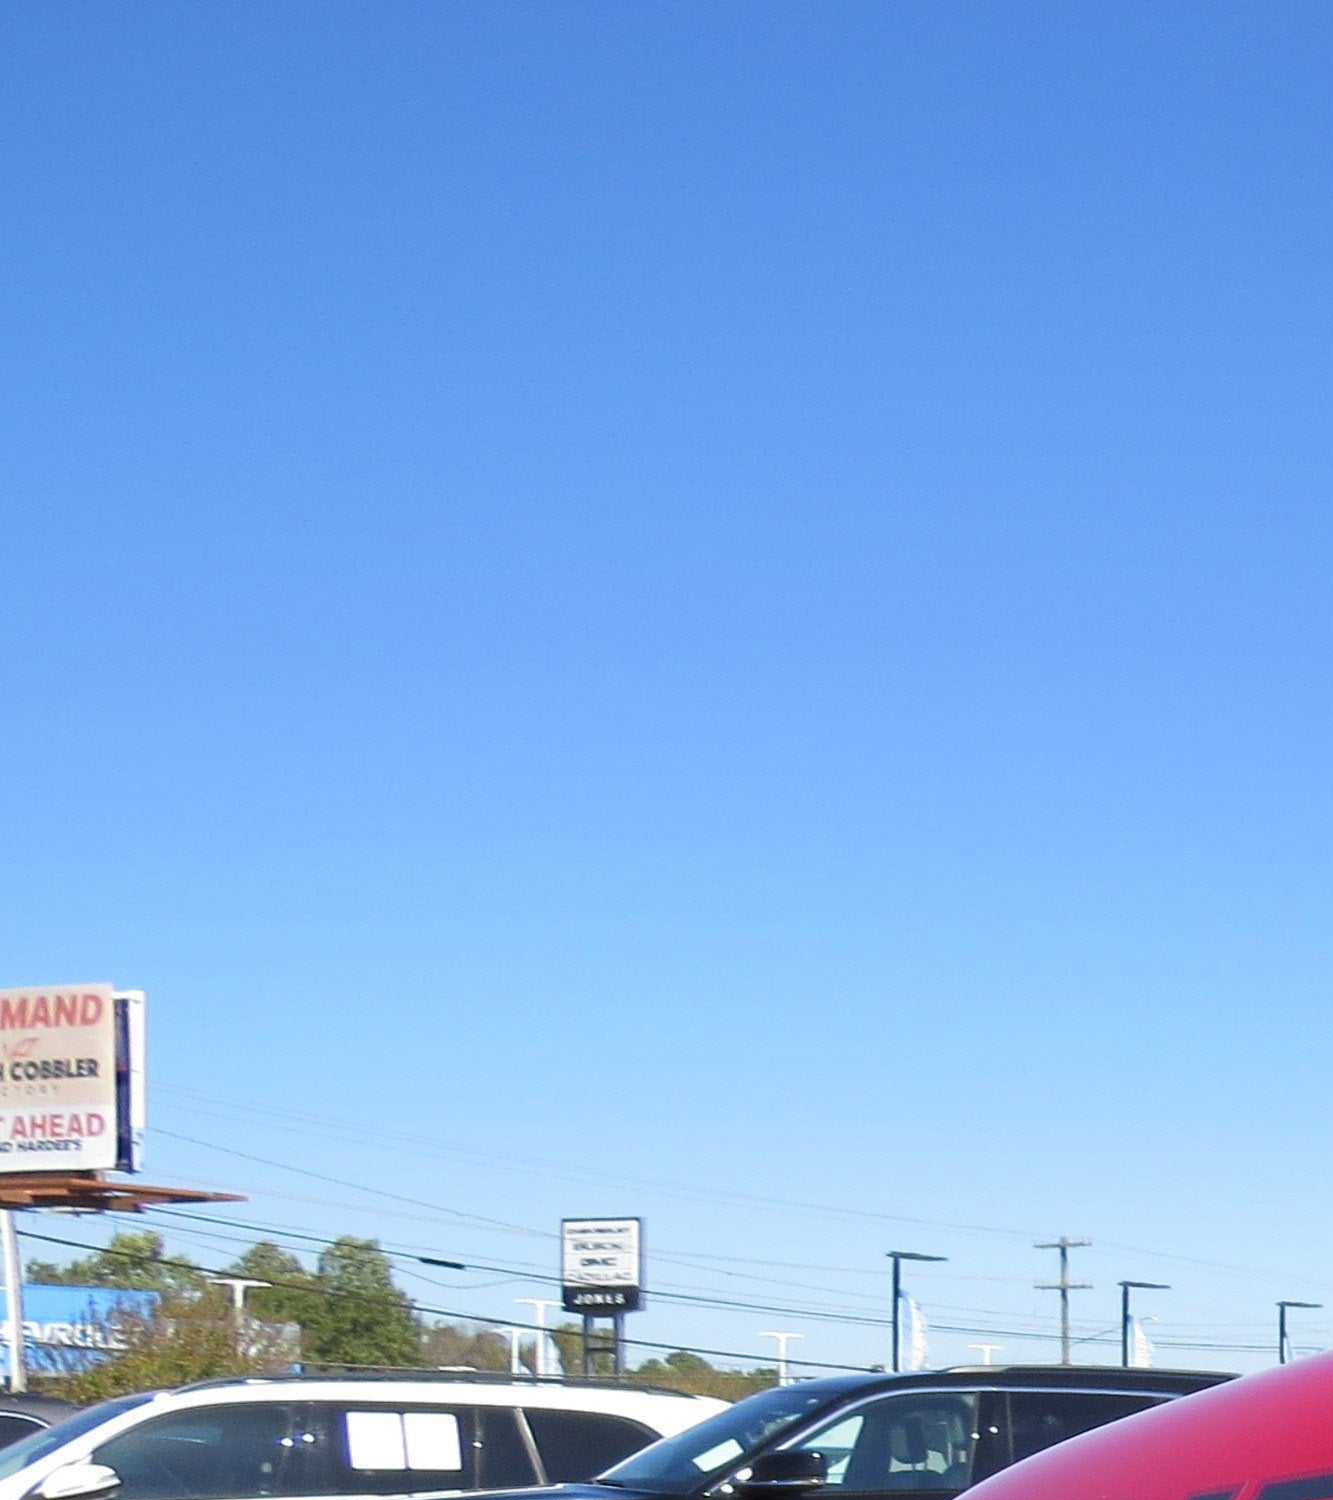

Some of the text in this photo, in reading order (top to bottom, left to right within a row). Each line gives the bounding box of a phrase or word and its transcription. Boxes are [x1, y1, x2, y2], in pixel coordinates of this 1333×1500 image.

[0, 994, 103, 1030] MAND
[10, 1058, 100, 1081] COBBLER
[11, 1112, 106, 1139] AHEAD
[572, 1293, 625, 1306] JONES
